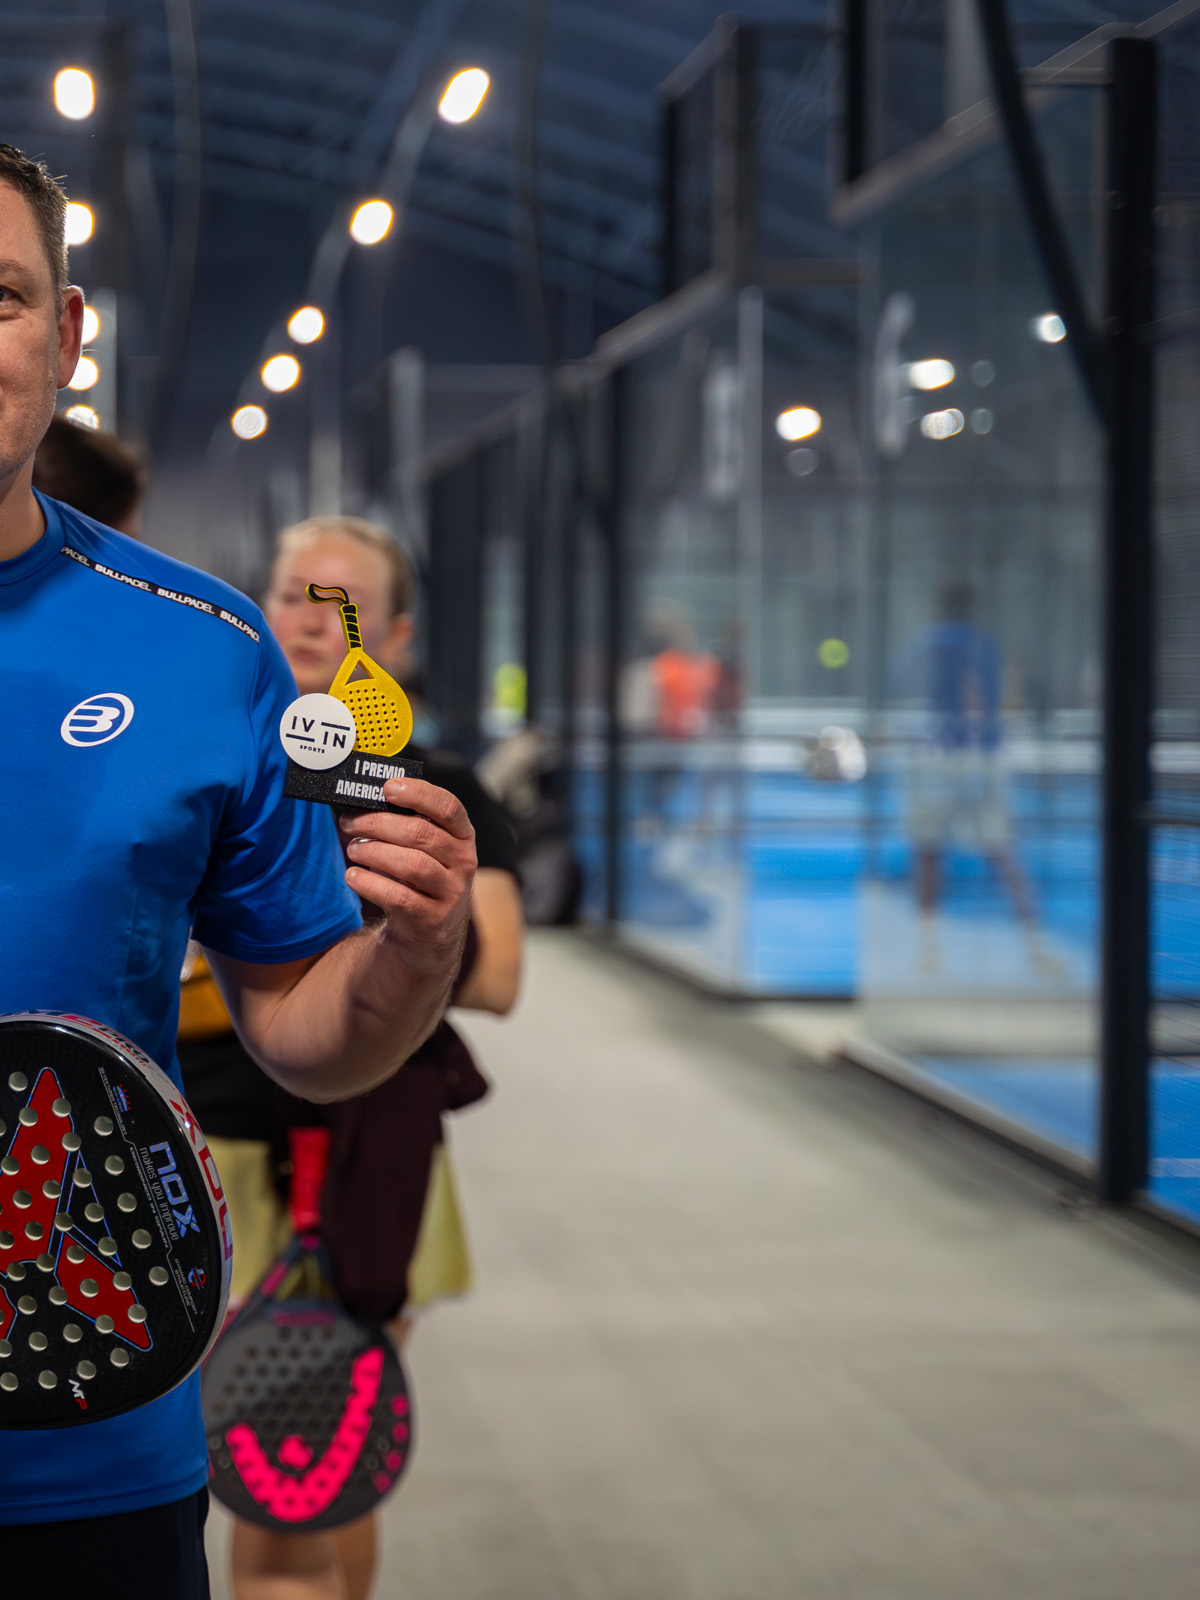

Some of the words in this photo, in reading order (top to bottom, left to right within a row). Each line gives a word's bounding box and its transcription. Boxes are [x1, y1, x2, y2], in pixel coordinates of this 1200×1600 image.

[95, 563, 152, 592] BULLPADEL
[157, 588, 215, 615] BULLPADEL
[299, 744, 325, 754] SPORTS
[361, 760, 406, 780] PREMIO
[129, 1146, 152, 1202] DESIGNED
[154, 1215, 169, 1249] SPAIN
[140, 1147, 157, 1180] makes
[151, 1181, 165, 1201] you
